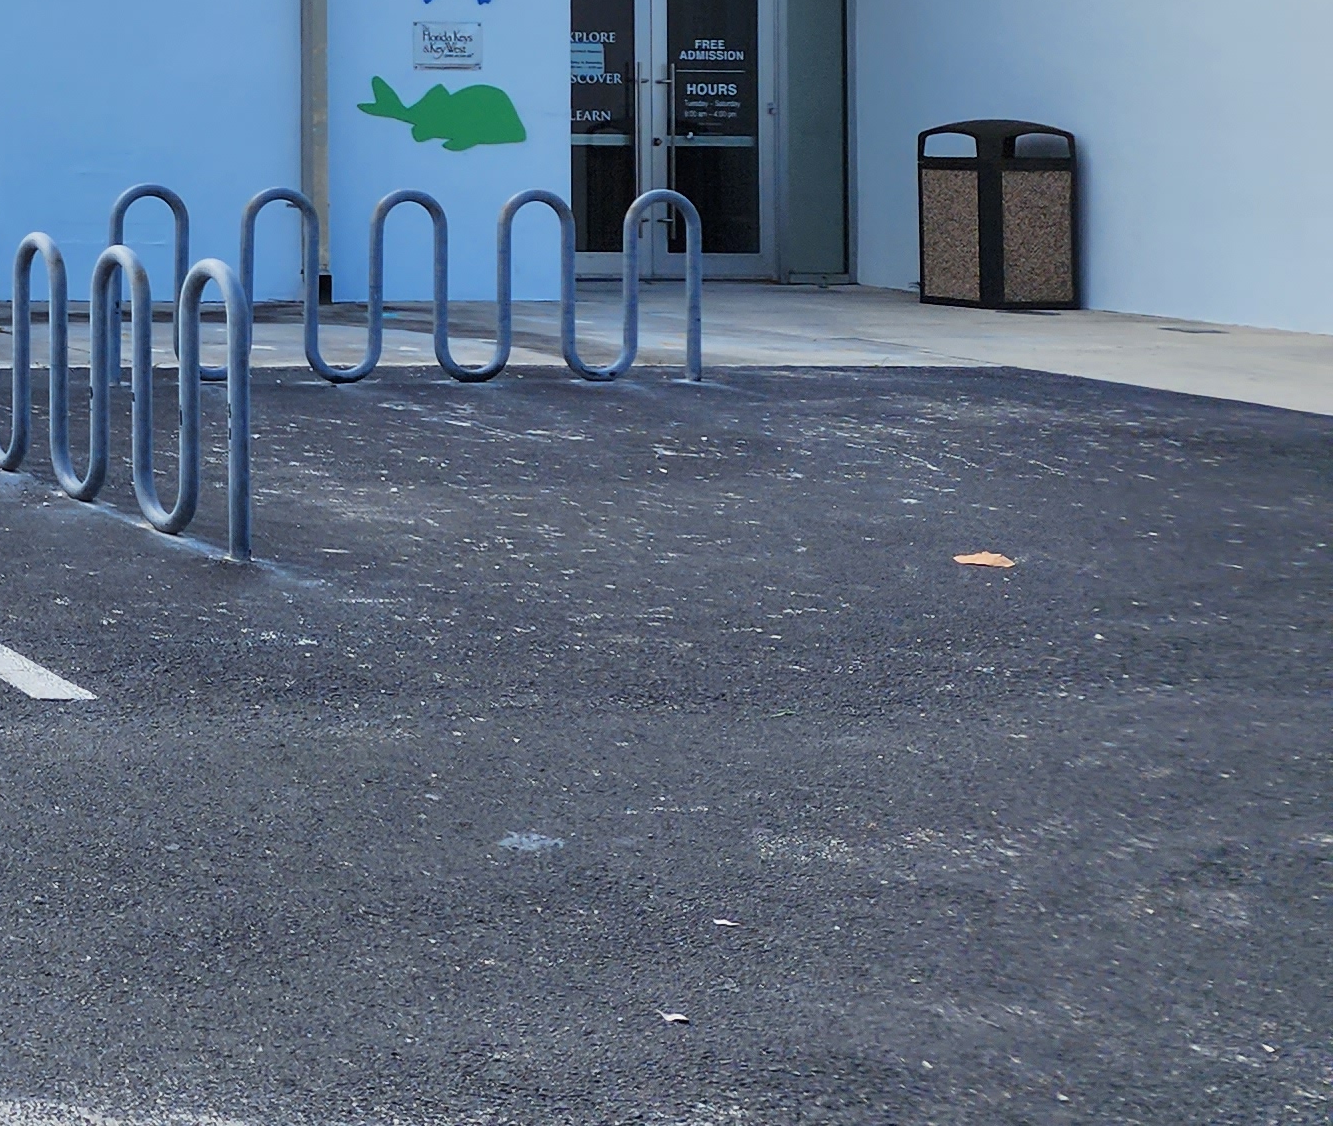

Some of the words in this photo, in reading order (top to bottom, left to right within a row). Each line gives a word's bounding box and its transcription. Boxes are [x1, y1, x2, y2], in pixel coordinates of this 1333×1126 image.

[694, 39, 726, 50] FREE
[679, 50, 745, 61] ADMISSION
[570, 73, 623, 84] SCOVER
[686, 83, 738, 96] HOURS
